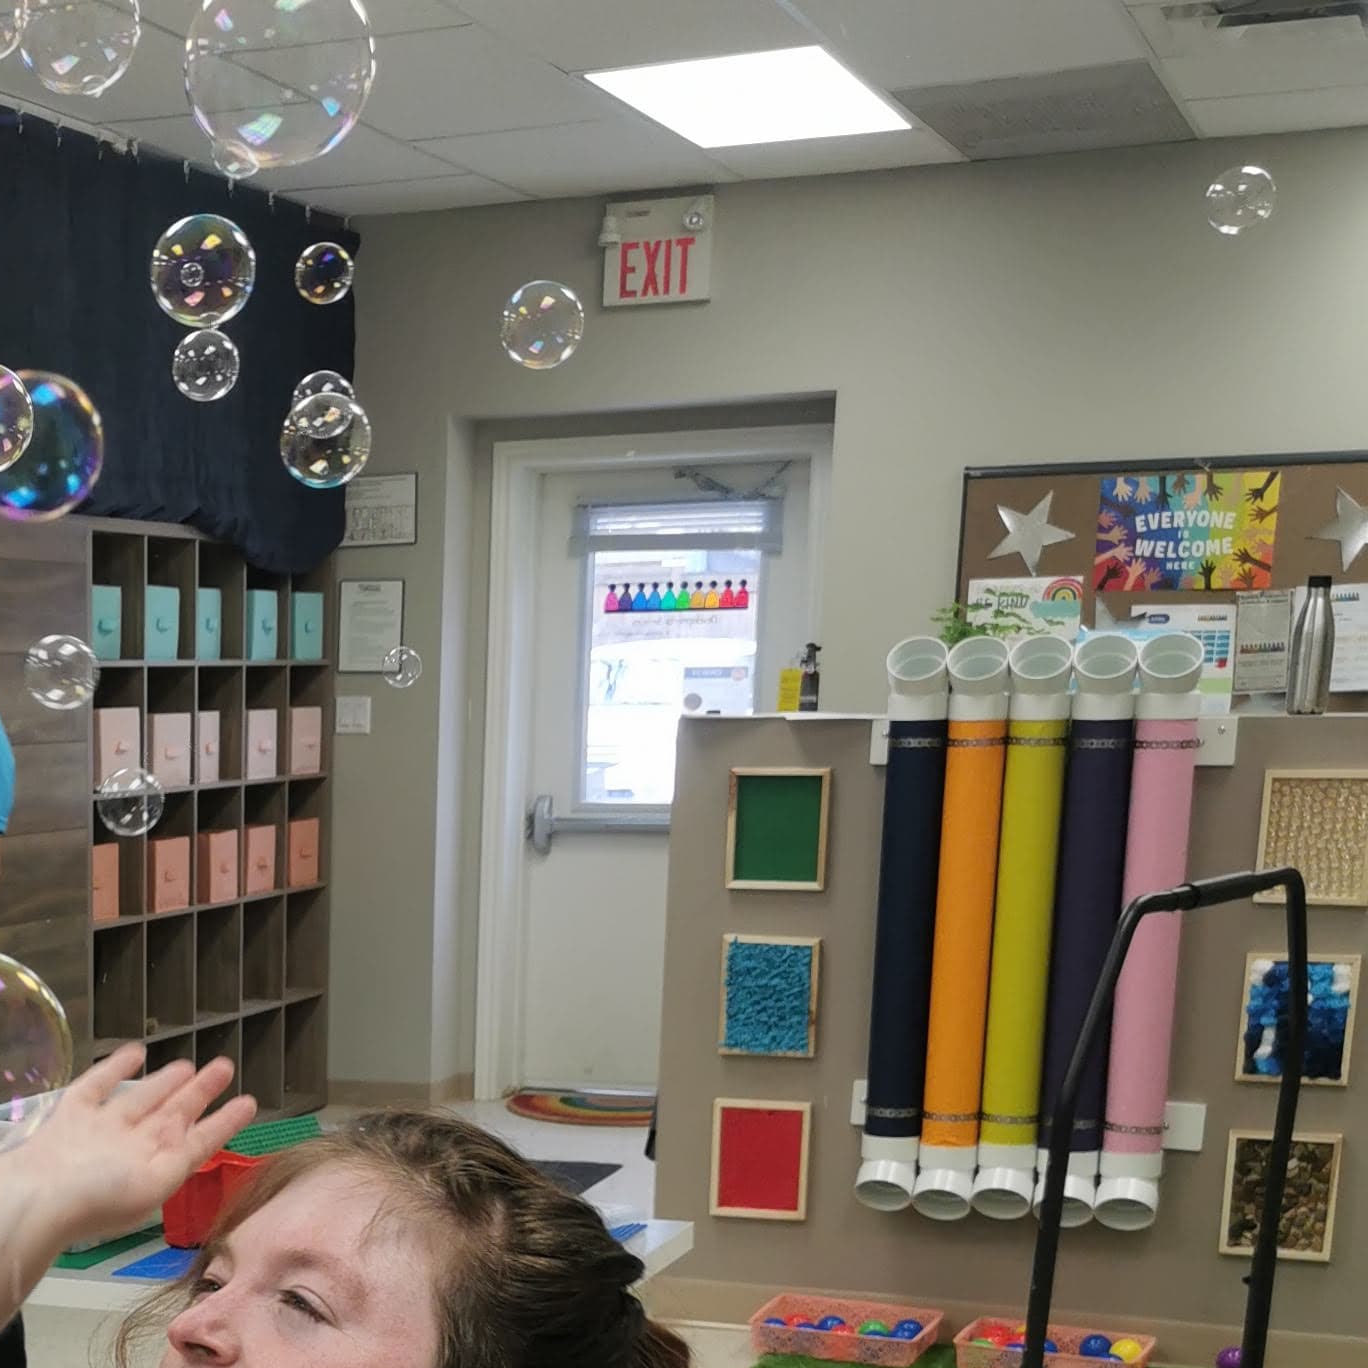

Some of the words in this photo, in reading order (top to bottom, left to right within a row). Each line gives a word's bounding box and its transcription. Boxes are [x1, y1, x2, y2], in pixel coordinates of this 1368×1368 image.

[619, 237, 696, 299] EXIT
[1135, 510, 1236, 533] EVERYONE
[1178, 530, 1190, 539] IS
[1135, 537, 1233, 558] WELCOME
[1166, 561, 1195, 570] HERE
